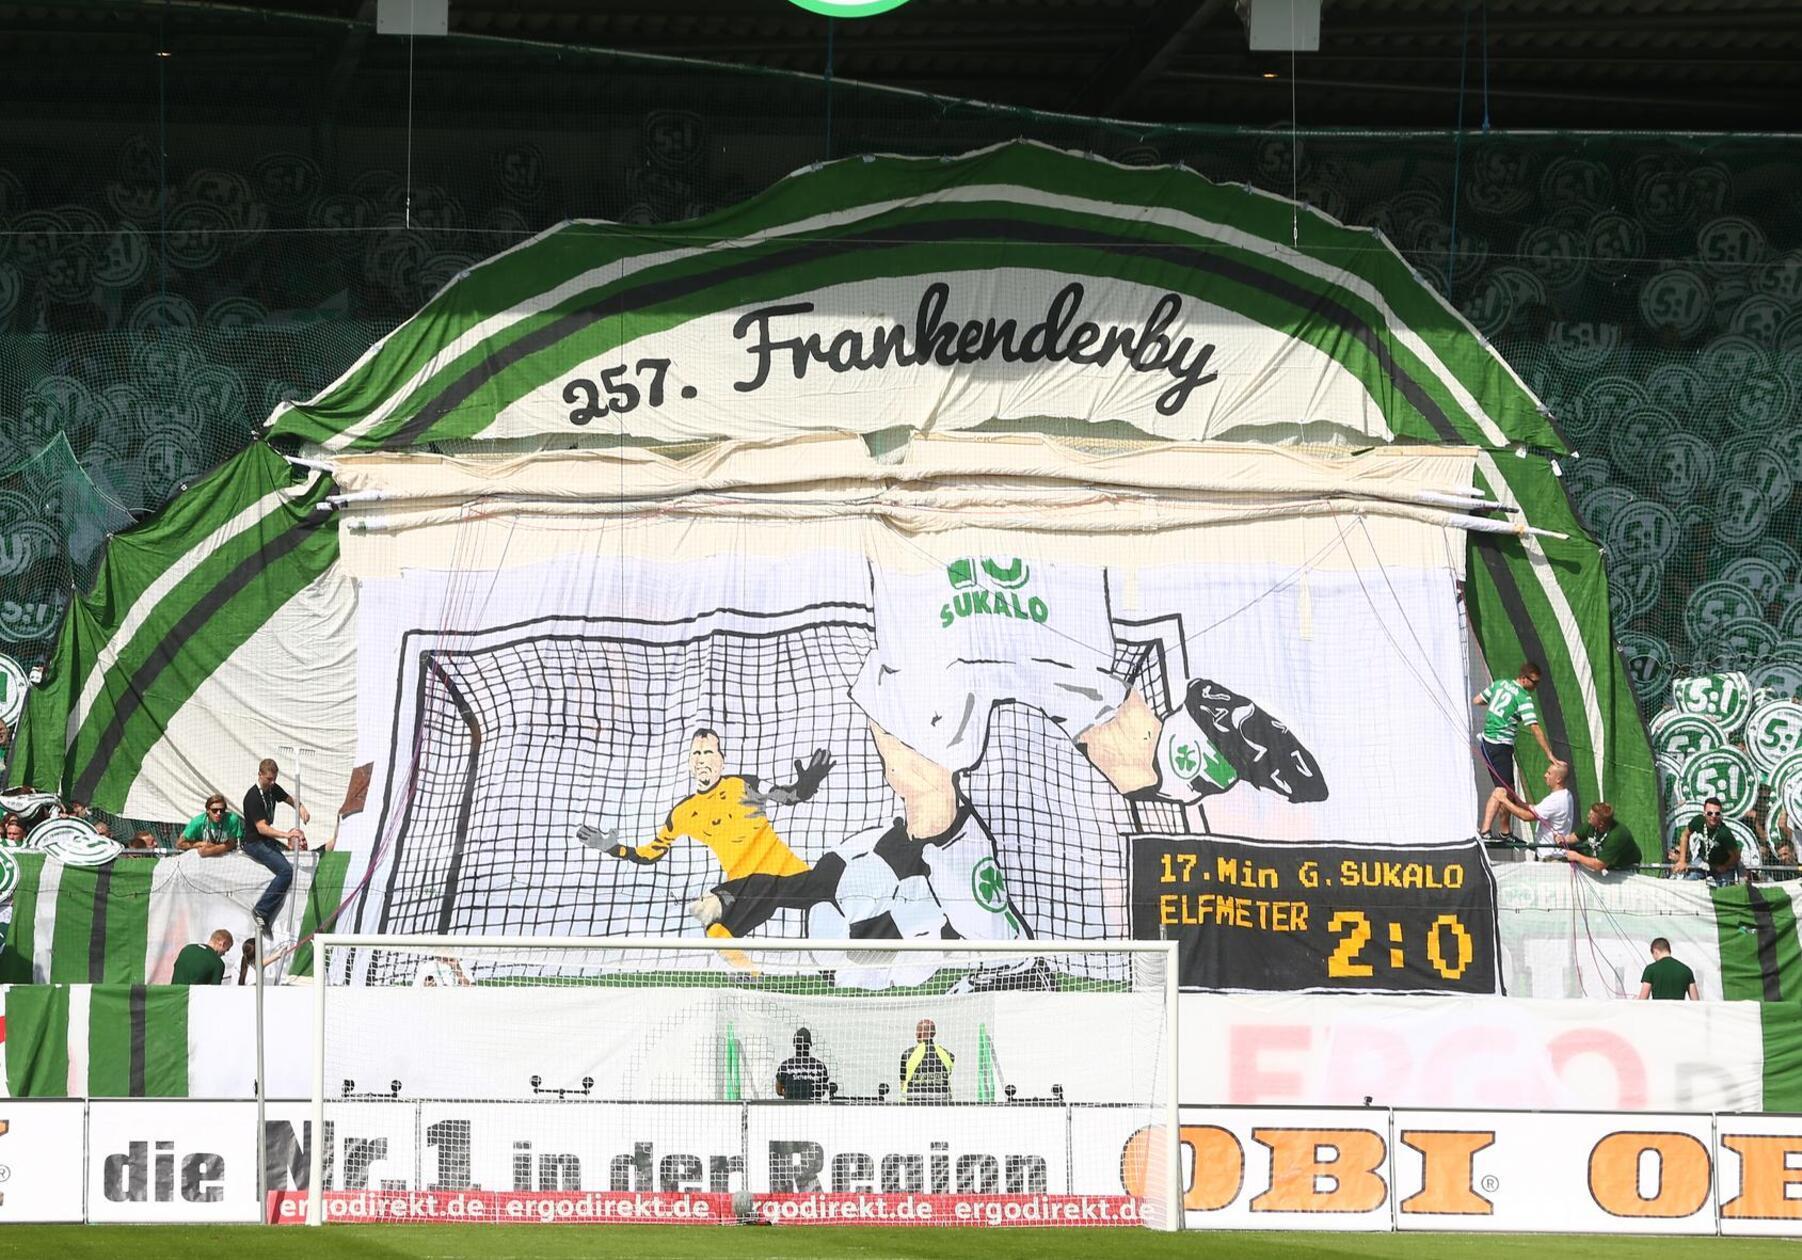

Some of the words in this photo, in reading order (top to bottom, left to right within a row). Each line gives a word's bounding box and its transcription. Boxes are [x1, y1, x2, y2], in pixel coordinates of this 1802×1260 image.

[653, 122, 694, 154] 5:1
[1708, 231, 1750, 262] 5:1
[1654, 286, 1698, 319] 5:1
[563, 358, 697, 425] 257.
[732, 282, 1217, 417] Frankenderby
[1659, 445, 1693, 483] 5:1
[1726, 491, 1762, 526] 5:1
[1623, 516, 1665, 550] 5:1
[940, 591, 1049, 628] SUKALO
[1488, 688, 1512, 718] 12
[1689, 677, 1735, 714] 5:1
[1696, 764, 1739, 801] 5:1
[1160, 854, 1279, 889] 17.Min
[1160, 895, 1309, 932] ELFMETER
[104, 1141, 225, 1202] die
[513, 1140, 581, 1192] in
[610, 1142, 745, 1193] der
[768, 1140, 1047, 1195] Region
[280, 1195, 484, 1219] erodirekt.de
[506, 1195, 710, 1222] ergodirekt.de
[955, 1197, 1154, 1225] ergodirekt.de
